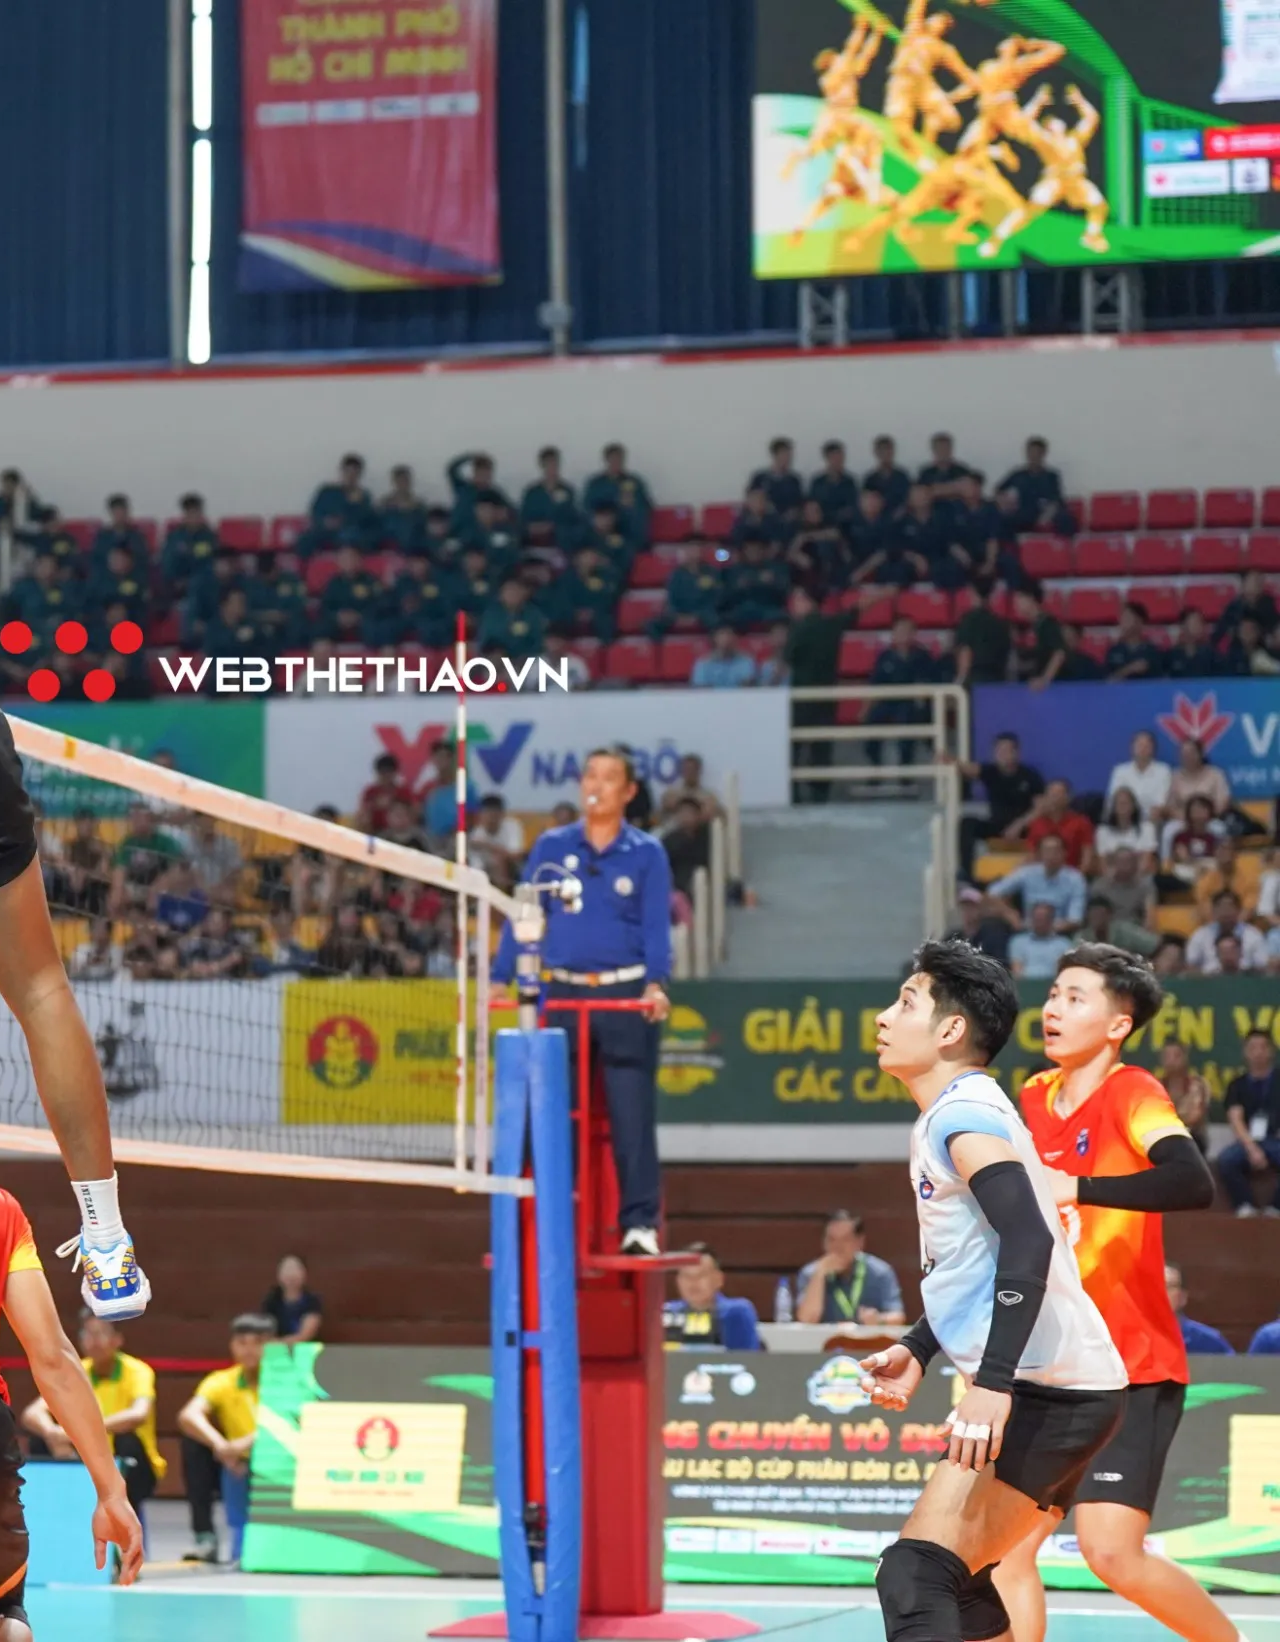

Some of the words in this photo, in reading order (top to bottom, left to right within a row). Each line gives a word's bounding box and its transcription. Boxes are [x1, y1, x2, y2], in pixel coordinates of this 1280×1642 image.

[531, 750, 584, 788] NA
[743, 996, 842, 1053] GIẢI
[775, 1062, 842, 1102] CÁC
[840, 1417, 890, 1451] VÔ
